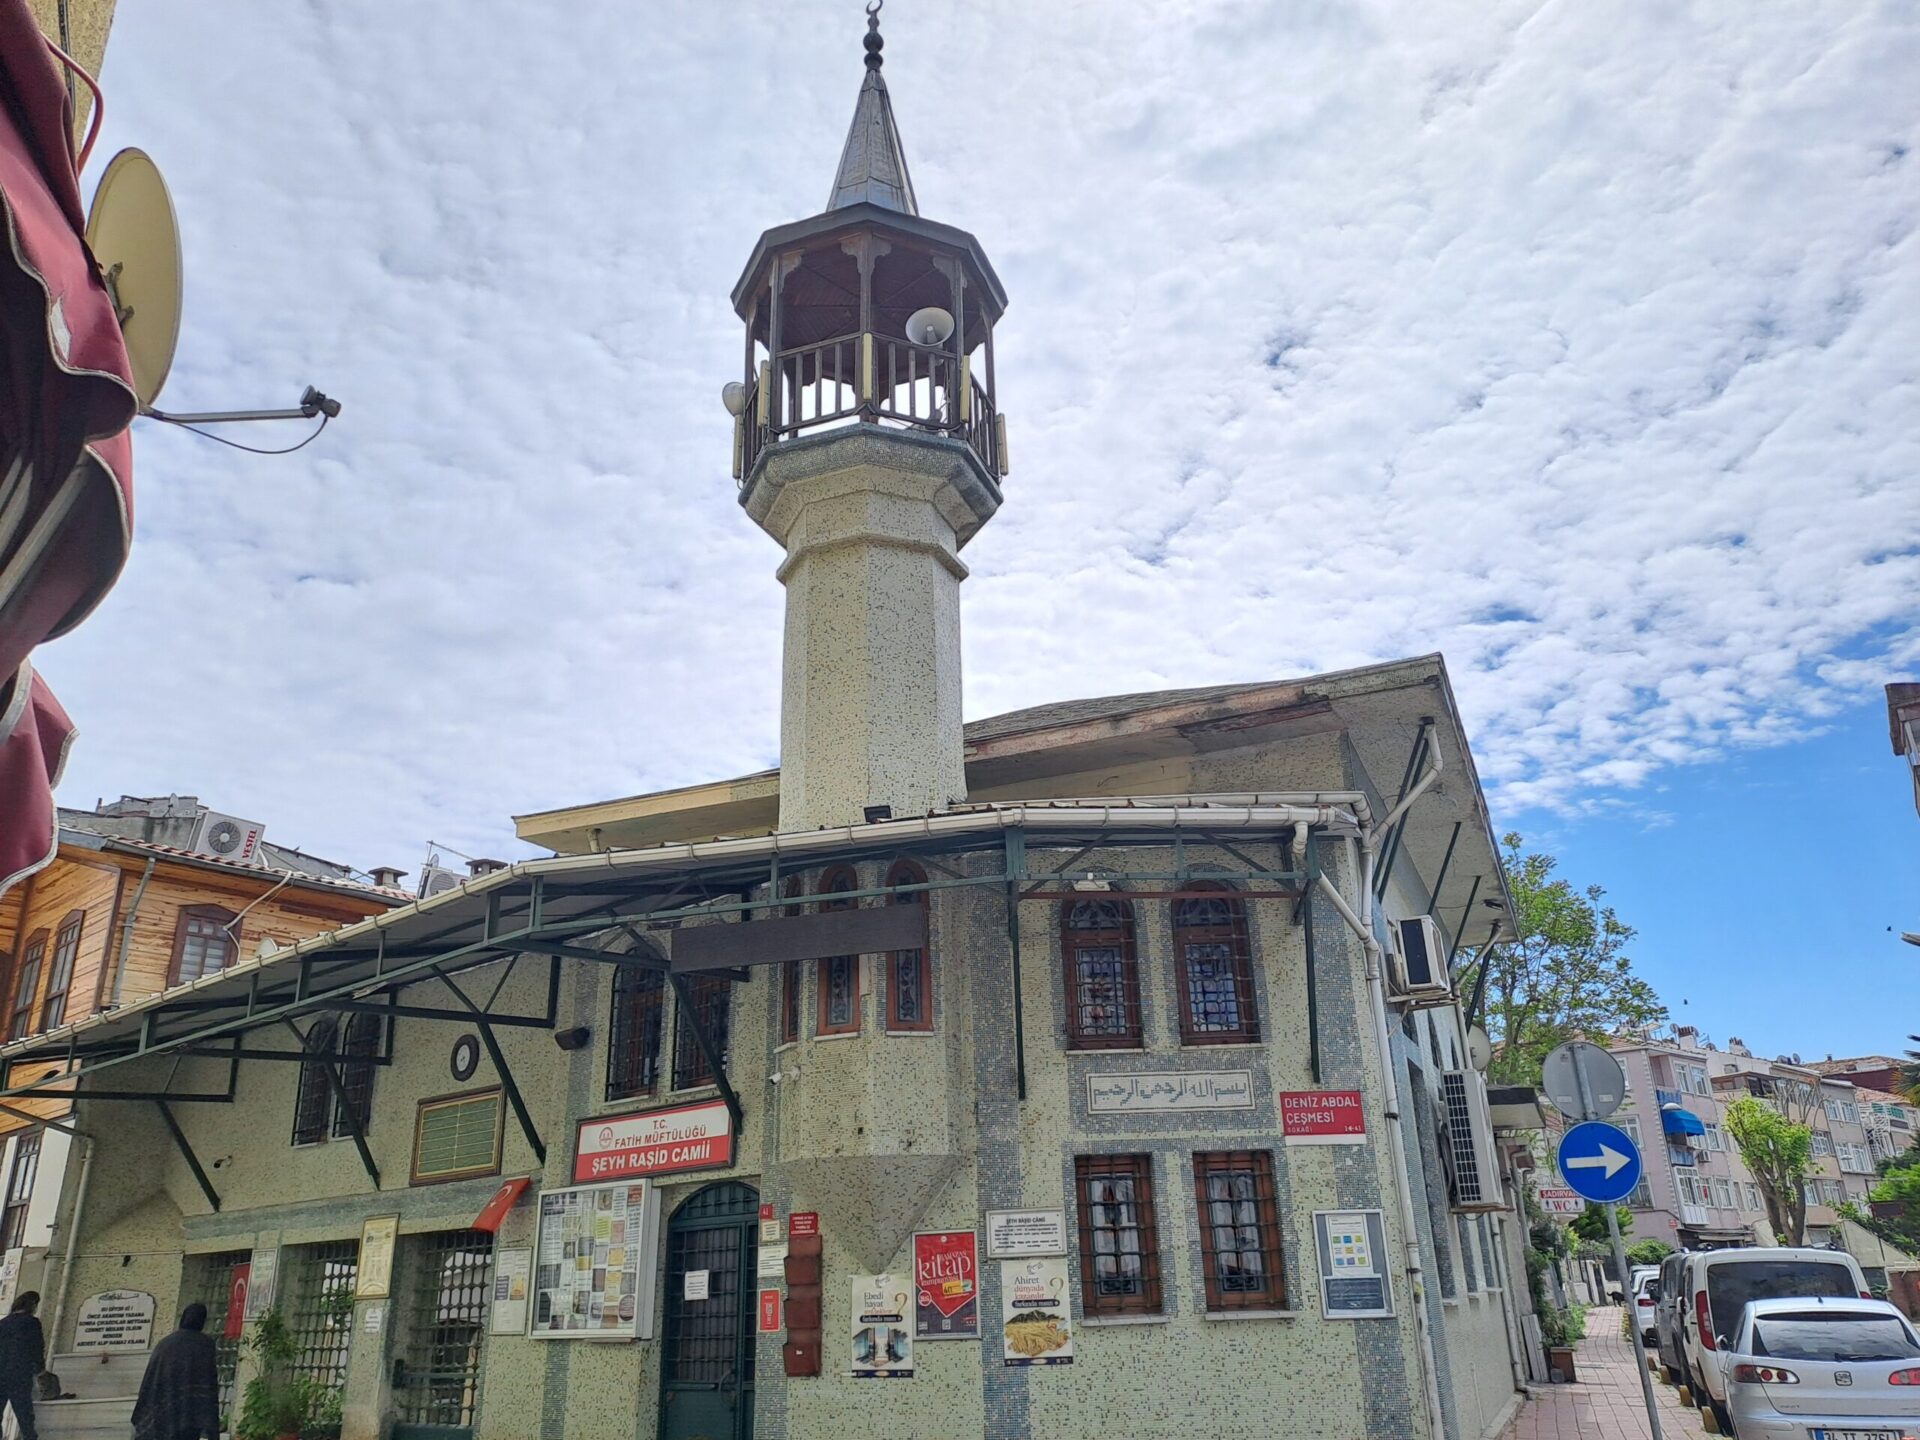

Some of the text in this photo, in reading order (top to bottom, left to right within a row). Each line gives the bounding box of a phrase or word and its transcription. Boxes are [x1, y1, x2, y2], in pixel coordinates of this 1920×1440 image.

[242, 829, 257, 859] VESTEL
[1284, 1096, 1359, 1108] DENİZ ABDAL
[1286, 1110, 1335, 1125] ÇEŞMESİ
[653, 1119, 668, 1130] T.C.
[614, 1125, 707, 1148] FATİH MÜFTÜLÜĞÜ
[592, 1140, 711, 1176] ŞEYH RAŞİD CAMİİ
[1552, 1200, 1571, 1211] WC
[918, 1253, 971, 1285] kitap
[1014, 1276, 1039, 1284] Ahiret
[1014, 1284, 1044, 1293] dünyada
